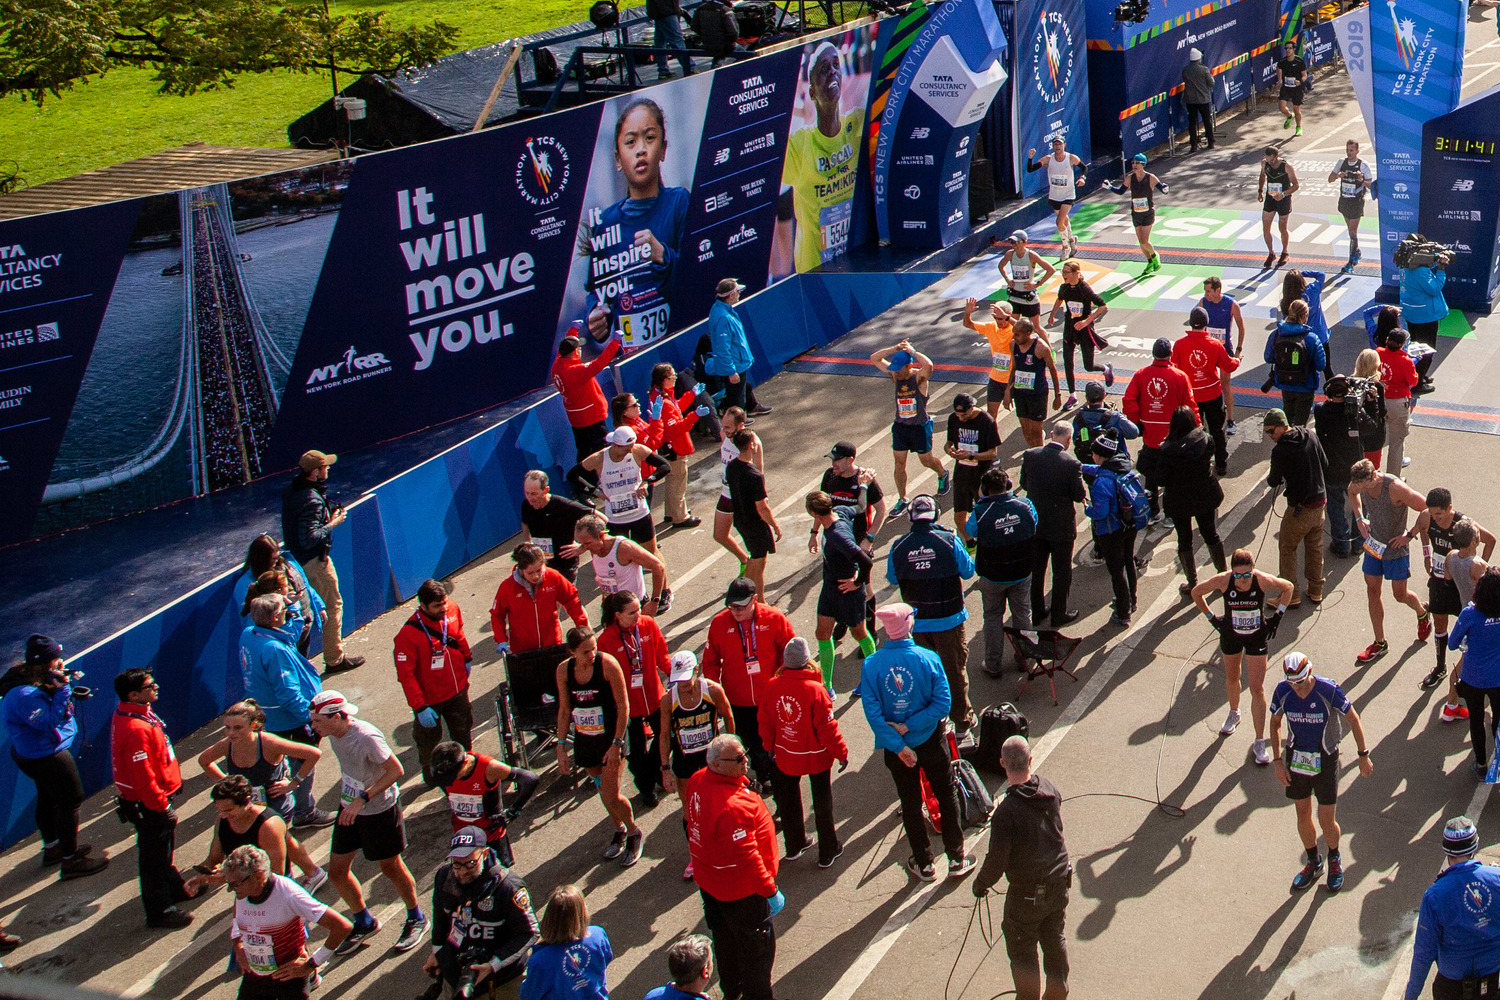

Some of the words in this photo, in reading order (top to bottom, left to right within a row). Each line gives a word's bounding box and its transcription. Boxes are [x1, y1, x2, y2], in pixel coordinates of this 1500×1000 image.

[1049, 11, 1063, 24] TCS
[1062, 22, 1074, 47] NEW
[1176, 34, 1198, 51] NYRR
[1347, 20, 1365, 73] 2019
[1033, 32, 1049, 103] MARATHON
[1064, 50, 1074, 87] YORK
[1403, 74, 1416, 96] NEW
[1412, 49, 1427, 73] YORK
[1422, 27, 1435, 48] CITY
[897, 56, 916, 86] CITY
[1413, 46, 1438, 96] MARATHON
[742, 75, 763, 89] TATA
[919, 82, 967, 91] CONSULTANCY
[1391, 73, 1406, 95] TCS
[728, 83, 776, 106] CONSULTANCY
[1049, 89, 1065, 105] CITY
[738, 97, 769, 115] SERVICES
[883, 90, 902, 127] YORK
[1050, 120, 1063, 131] TATA
[536, 136, 555, 146] TCS
[740, 143, 766, 156] AIRLINES
[744, 136, 765, 148] UNITED
[555, 142, 570, 161] NEW
[817, 143, 853, 172] PASCAL
[876, 135, 888, 169] NEW
[1382, 158, 1421, 166] CONSULTANCY
[515, 153, 538, 206] MARATHON
[559, 163, 570, 191] YORK
[814, 180, 840, 198] TEAM
[875, 174, 885, 205] TCS
[397, 186, 435, 230] It
[540, 192, 559, 206] CITY
[540, 216, 556, 225] TATA
[588, 207, 603, 228] It
[530, 219, 566, 236] CONSULTANCY
[537, 228, 561, 240] SERVICES
[727, 227, 757, 246] NYRR
[399, 213, 486, 272] will
[590, 223, 622, 252] will
[592, 242, 652, 277] inspire
[697, 251, 714, 263] TATA
[405, 252, 535, 315] move
[594, 277, 634, 307] you.
[623, 320, 632, 336] C
[640, 308, 668, 341] 379
[409, 309, 514, 371] you.
[305, 350, 391, 385] NYRR
[306, 384, 323, 394] NEW
[324, 380, 342, 390] YORK
[343, 374, 362, 385] ROAD
[362, 365, 393, 379] RUNNERS
[959, 428, 979, 441] SWIM
[617, 501, 631, 510] 7552
[1004, 526, 1015, 535] 24
[1435, 537, 1453, 549] LEIVA
[915, 561, 931, 569] 225
[1239, 617, 1254, 627] 9020
[581, 715, 595, 726] 5415
[687, 731, 707, 744] 10298
[458, 802, 473, 812] 4257
[244, 909, 266, 918] SUISSE
[247, 934, 267, 946] PETER
